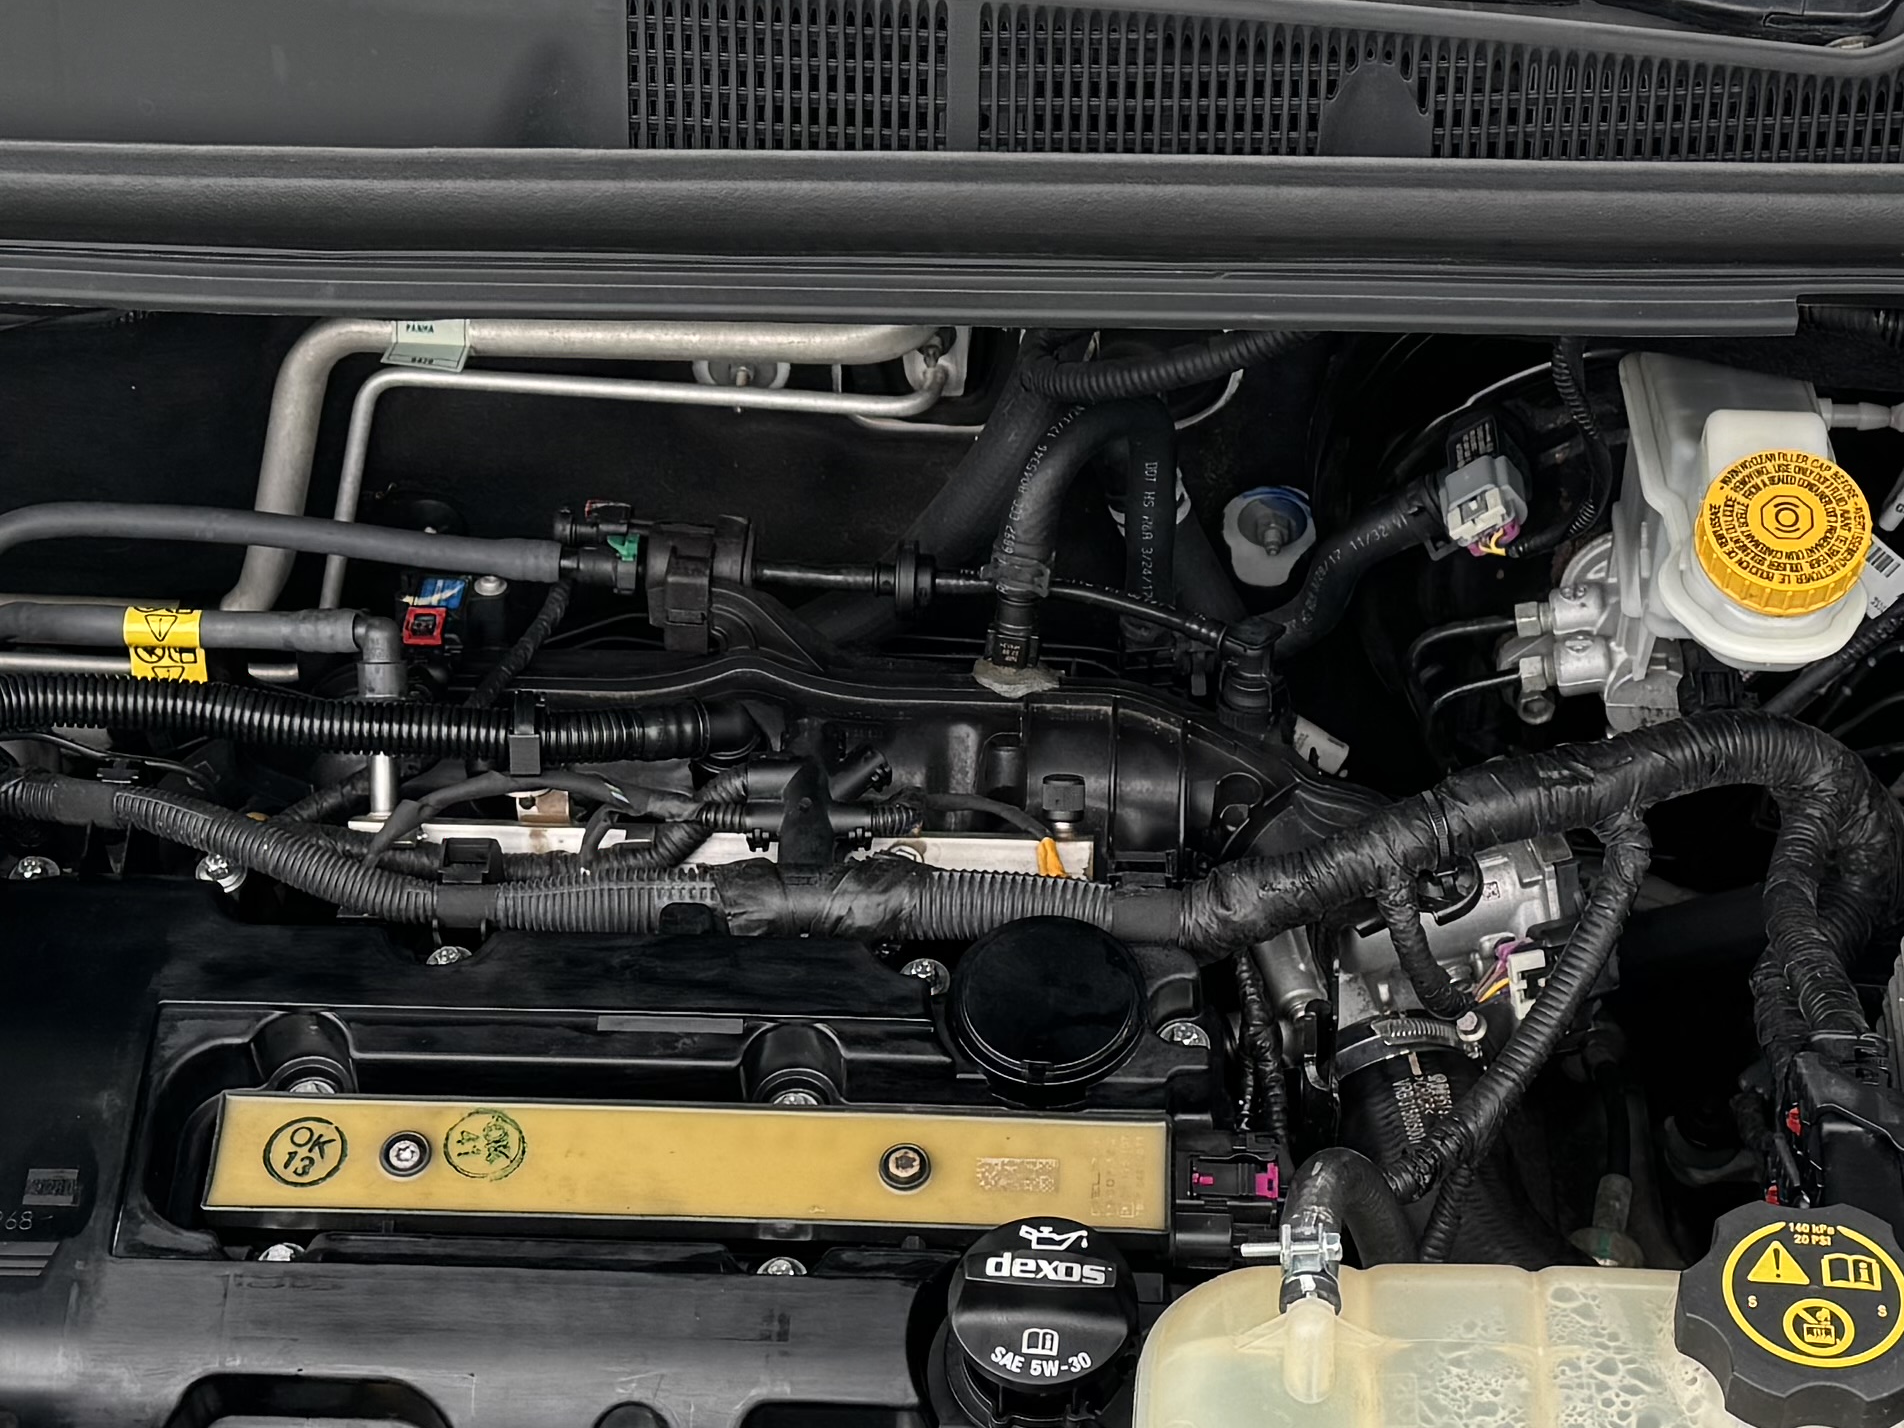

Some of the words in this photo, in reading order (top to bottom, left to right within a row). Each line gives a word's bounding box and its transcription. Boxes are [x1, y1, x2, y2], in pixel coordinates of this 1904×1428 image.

[1810, 458, 1832, 474] CAP
[289, 1126, 336, 1161] OK
[1788, 1222, 1809, 1234] 140
[1811, 1223, 1836, 1236] kPa
[1793, 1234, 1809, 1245] 20
[1811, 1235, 1832, 1247] PSI
[985, 1252, 1106, 1285] dexos
[1747, 1295, 1758, 1308] S
[1877, 1305, 1888, 1317] S
[990, 1346, 1026, 1373] SAE
[1030, 1352, 1092, 1377] 5W-30
